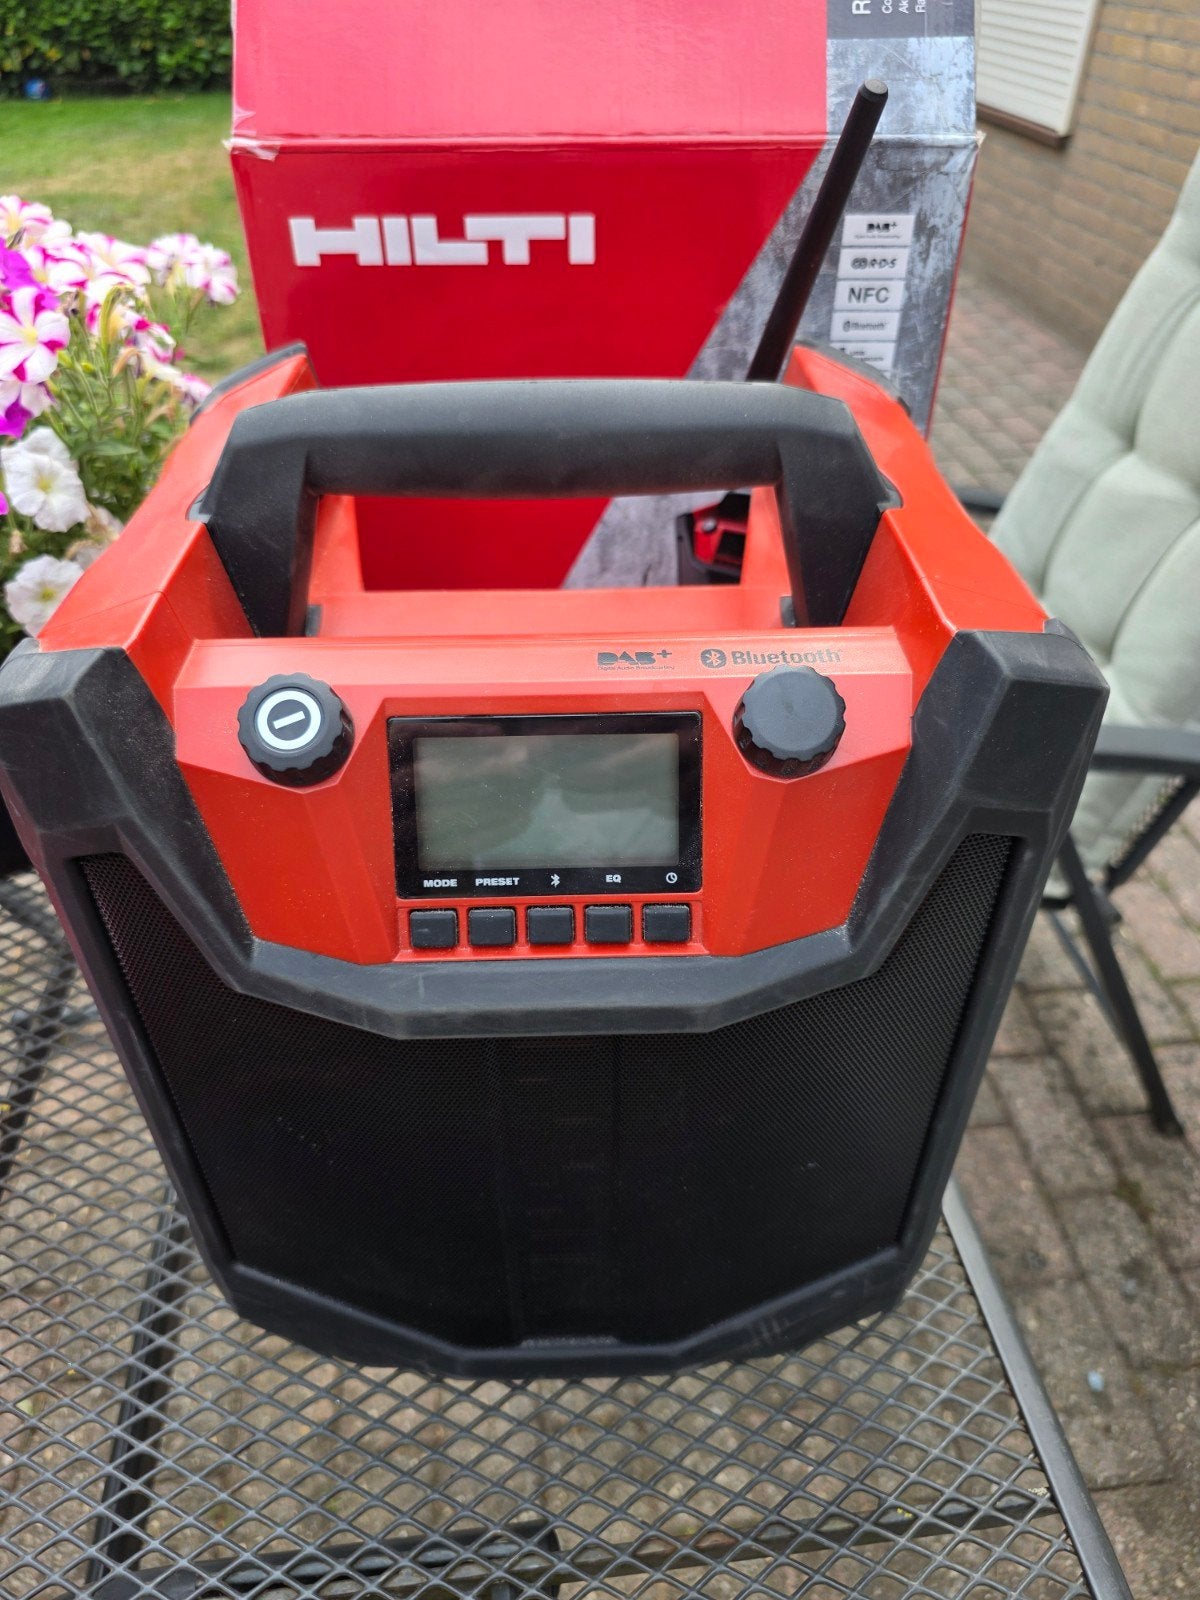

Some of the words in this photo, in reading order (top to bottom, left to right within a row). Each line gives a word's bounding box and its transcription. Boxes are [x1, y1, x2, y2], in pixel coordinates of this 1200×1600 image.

[288, 212, 596, 267] HILTI
[848, 286, 890, 303] NFC
[597, 649, 673, 666] DAB+
[731, 648, 842, 665] Bluetooth
[423, 878, 458, 888] MODE
[475, 877, 520, 887] PRESET
[605, 874, 622, 884] EQ
